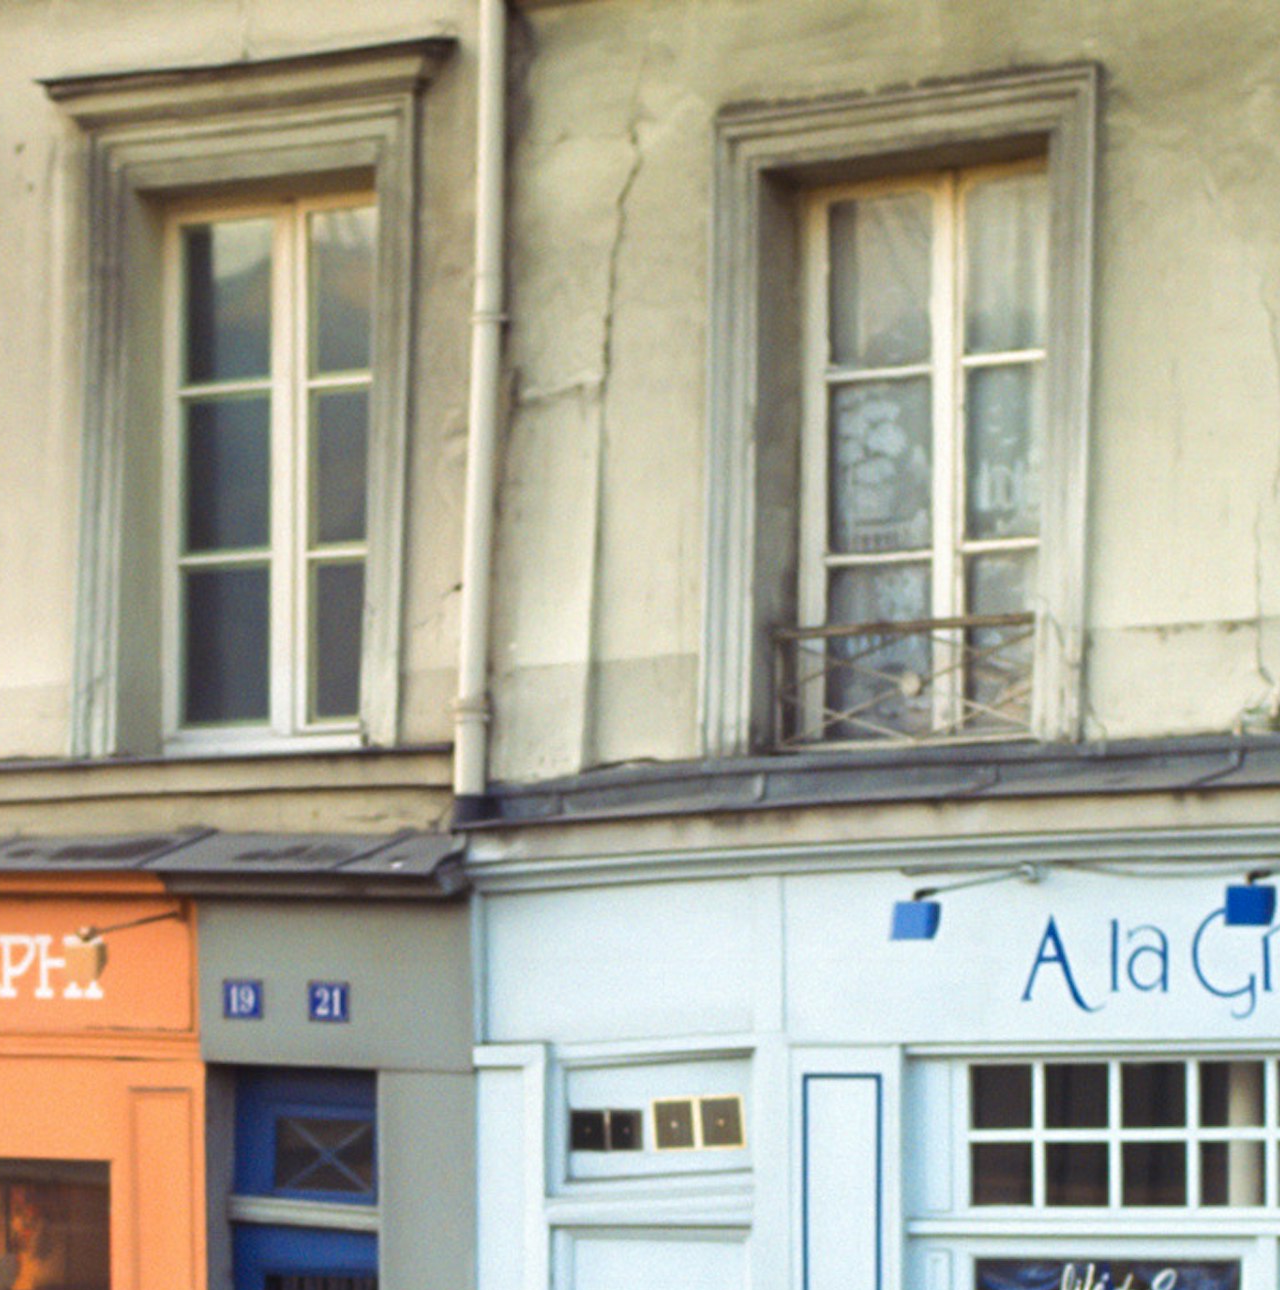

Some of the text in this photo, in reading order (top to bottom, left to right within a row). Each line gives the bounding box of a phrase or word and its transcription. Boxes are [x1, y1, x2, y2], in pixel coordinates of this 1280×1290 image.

[1021, 914, 1106, 1013] A
[1110, 918, 1170, 993] la
[229, 984, 256, 1014] 19
[315, 986, 342, 1017] 21
